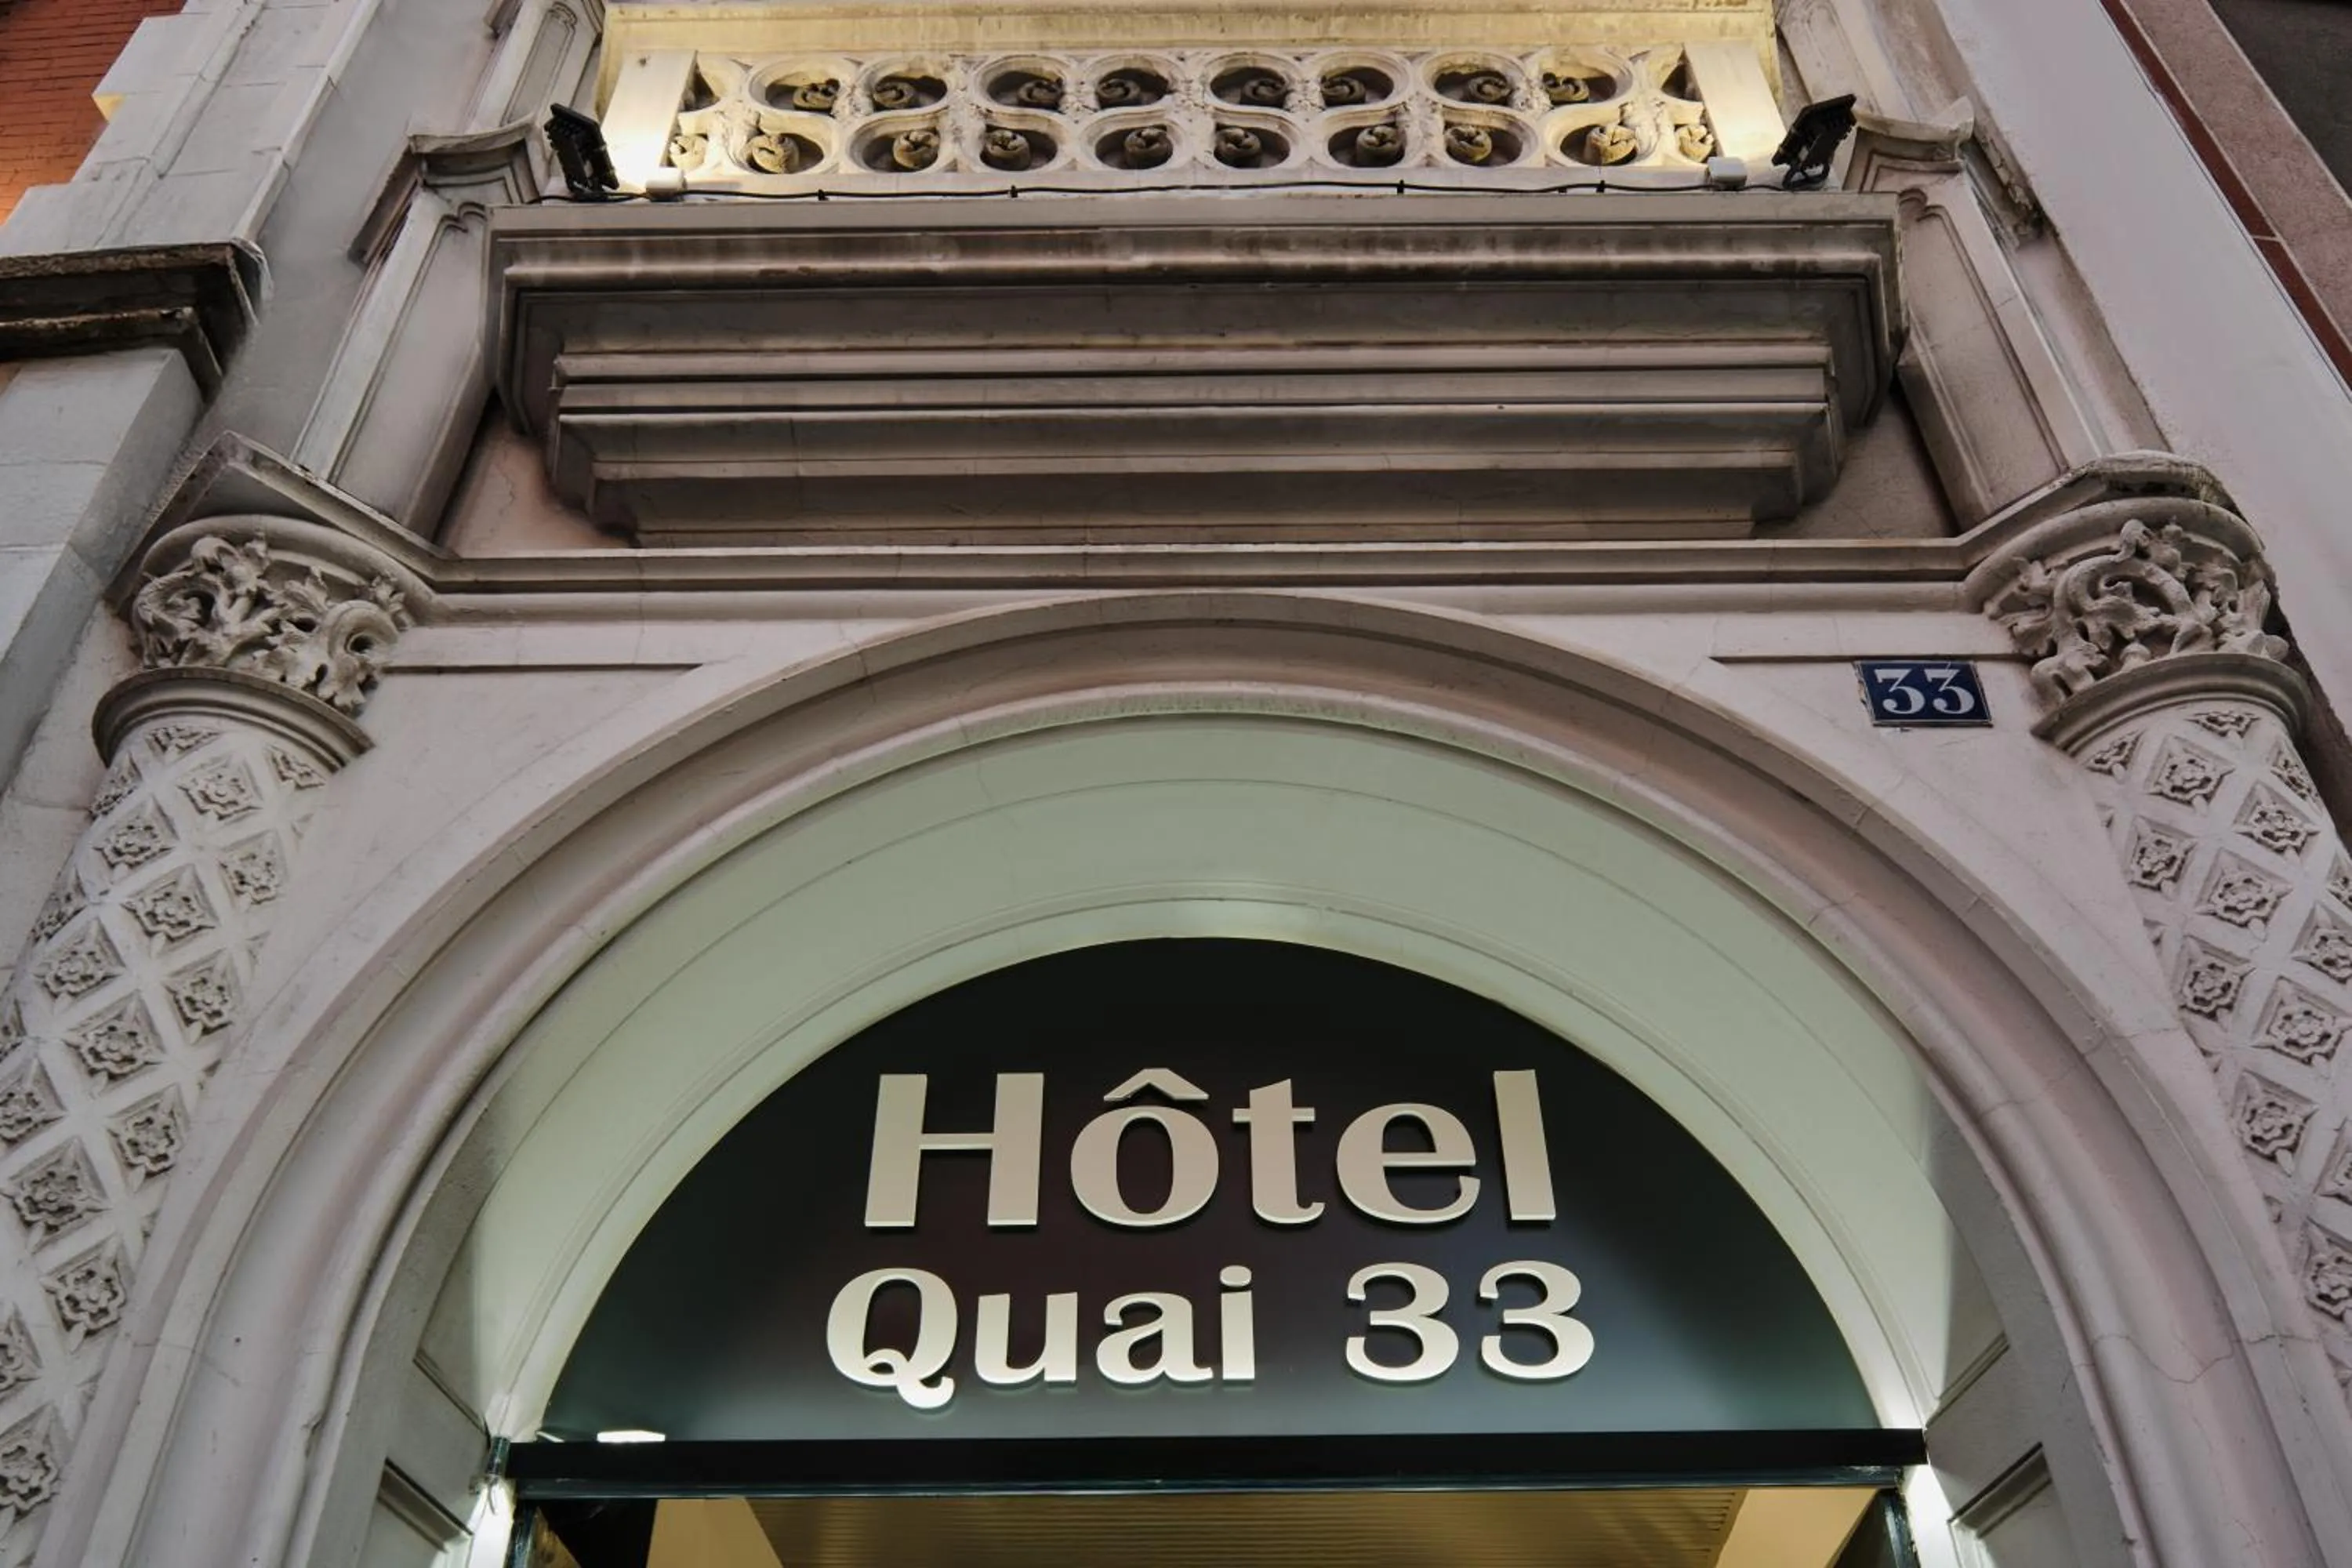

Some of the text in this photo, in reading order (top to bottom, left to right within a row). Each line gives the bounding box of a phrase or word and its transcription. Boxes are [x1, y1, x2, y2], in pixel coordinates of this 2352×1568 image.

[1873, 668, 1976, 715] 33
[864, 1067, 1557, 1228] Hôtel
[826, 1259, 1596, 1410] Quai 33
